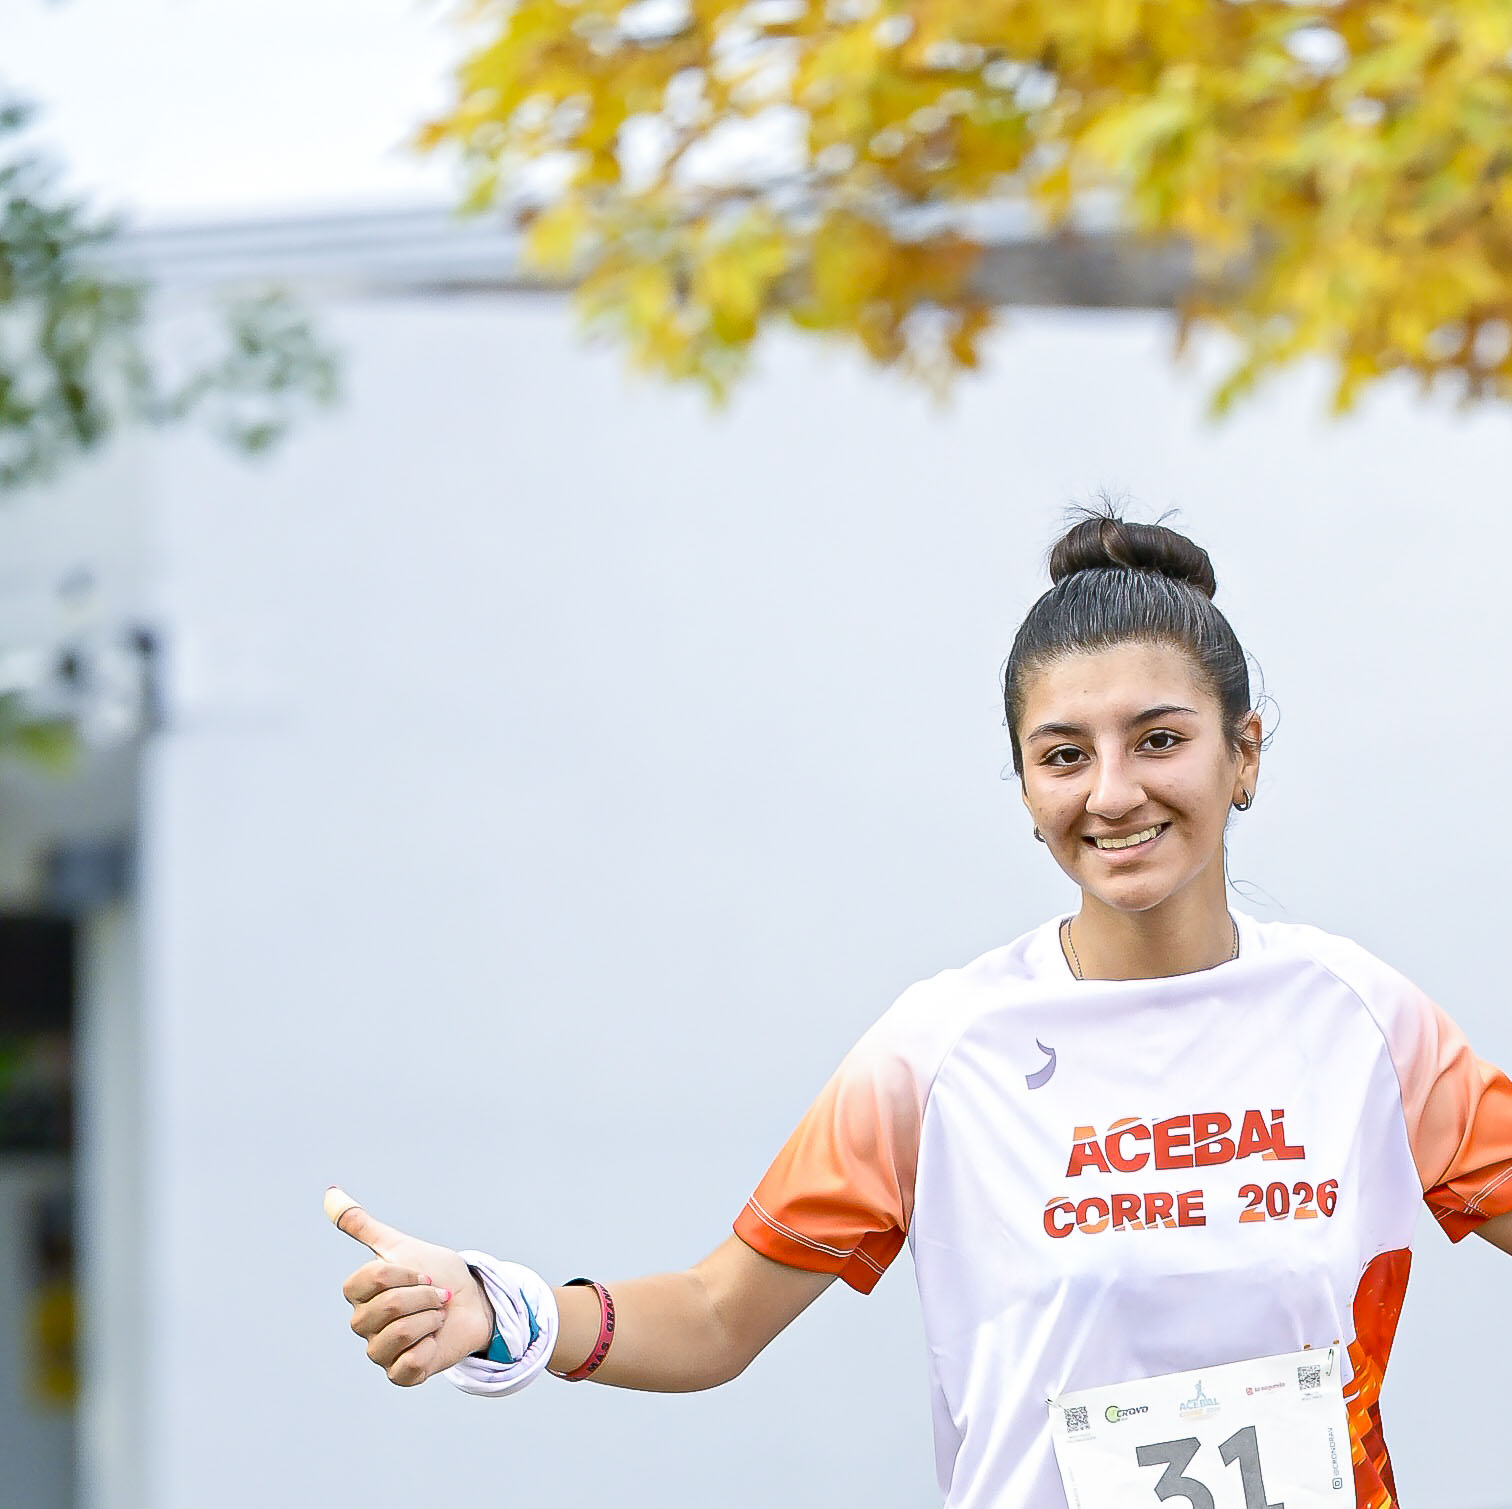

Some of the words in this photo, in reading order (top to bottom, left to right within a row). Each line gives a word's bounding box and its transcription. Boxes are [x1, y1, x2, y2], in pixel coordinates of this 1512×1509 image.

[1065, 1108, 1306, 1178] ACEBAL
[1043, 1189, 1207, 1239] CORRE
[1238, 1178, 1339, 1224] 2026
